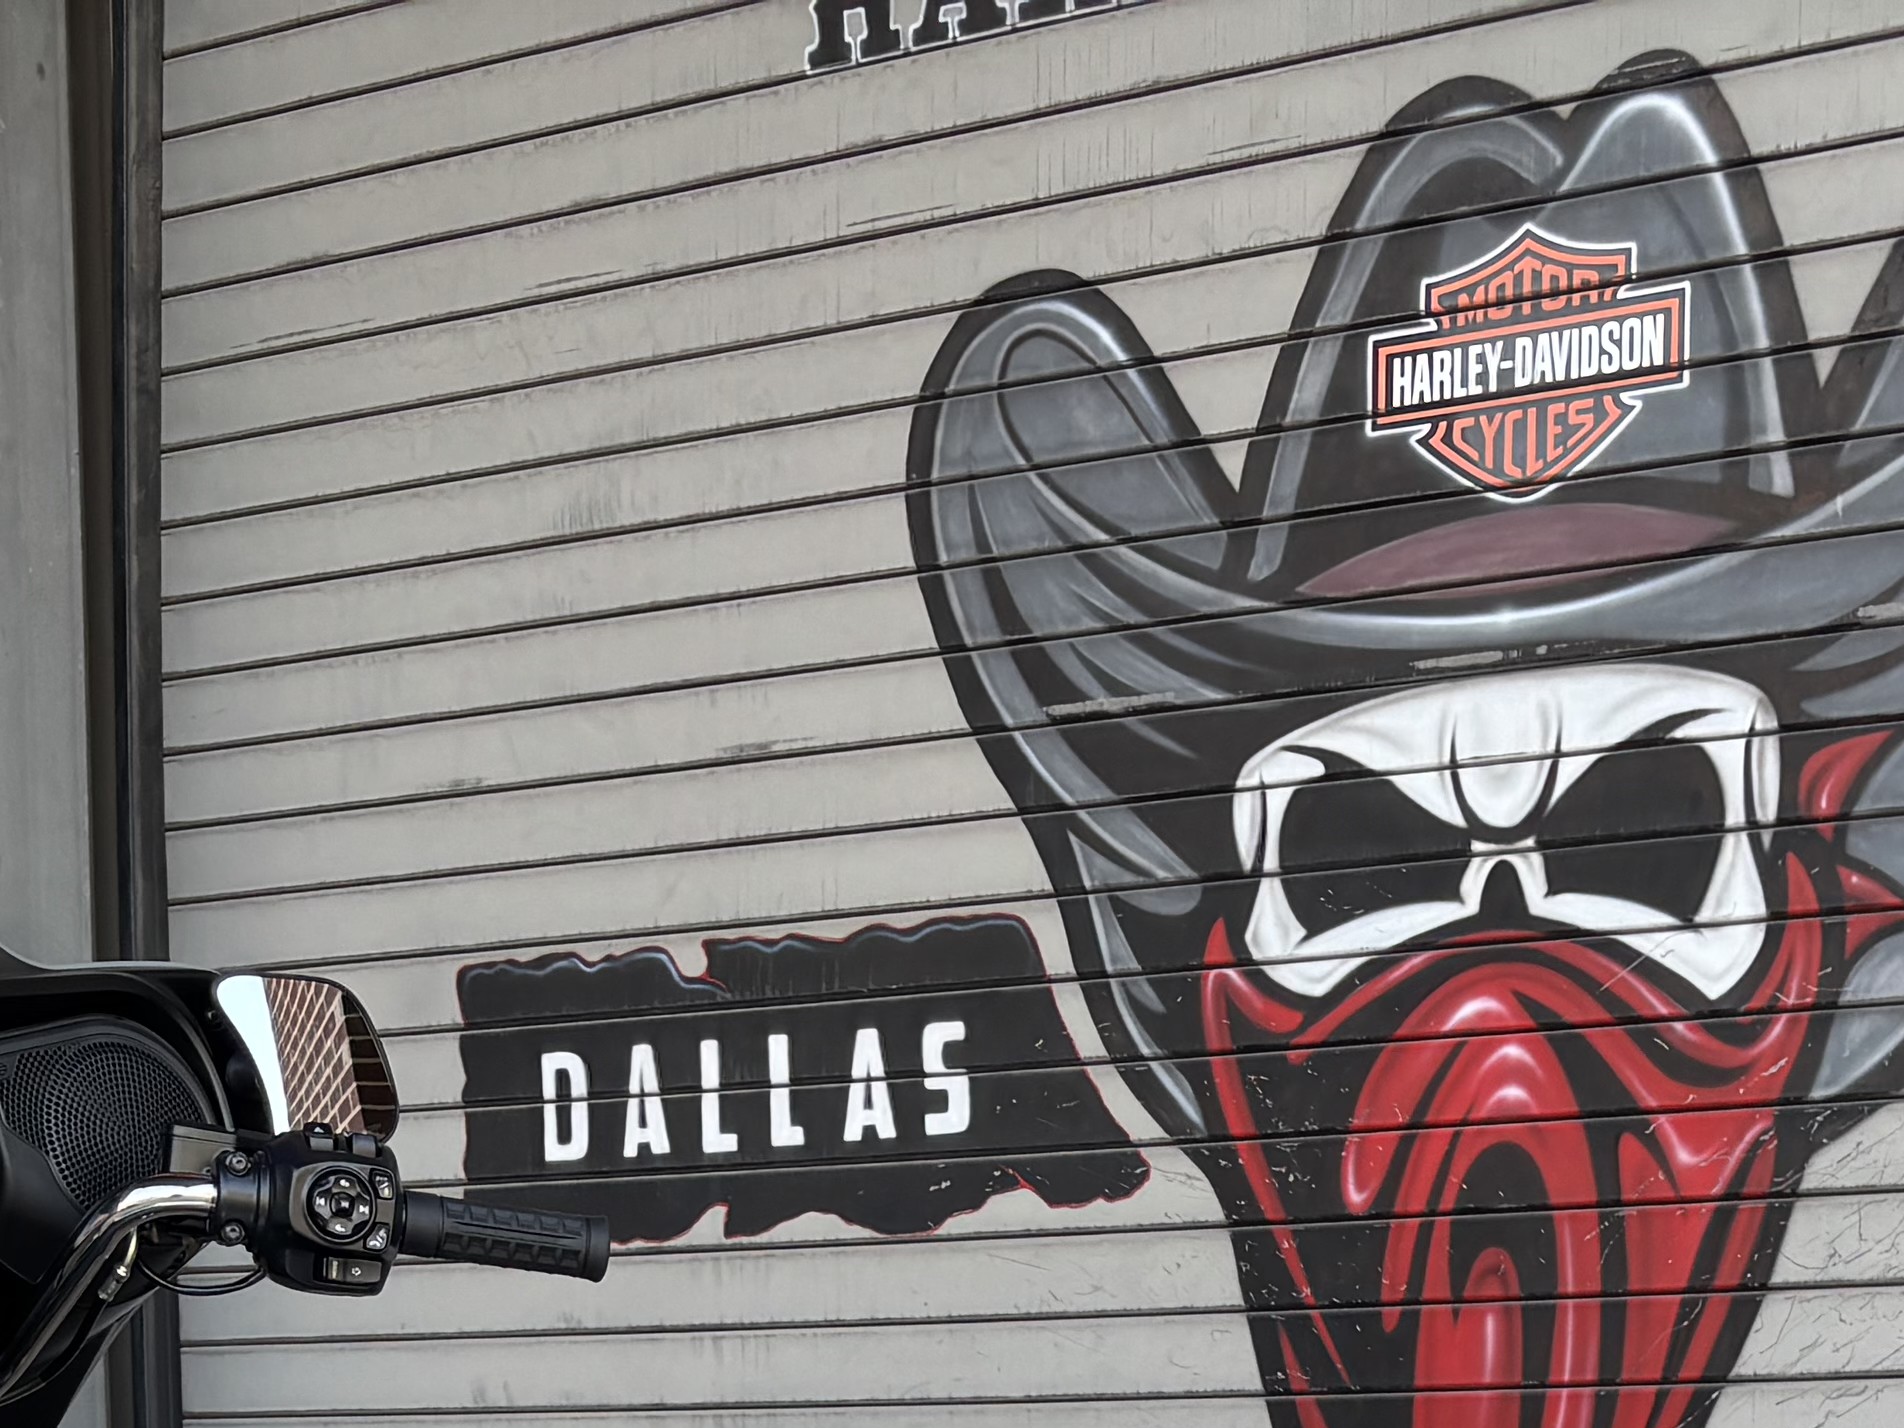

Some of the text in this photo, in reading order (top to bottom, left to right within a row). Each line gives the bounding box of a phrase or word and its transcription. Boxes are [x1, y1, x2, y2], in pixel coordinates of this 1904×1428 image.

[1456, 256, 1600, 328] MOTOR
[1391, 312, 1666, 409] HARLEY-DAVIDSON
[1451, 396, 1595, 479] CYCLES
[539, 1020, 973, 1163] DALLAS
